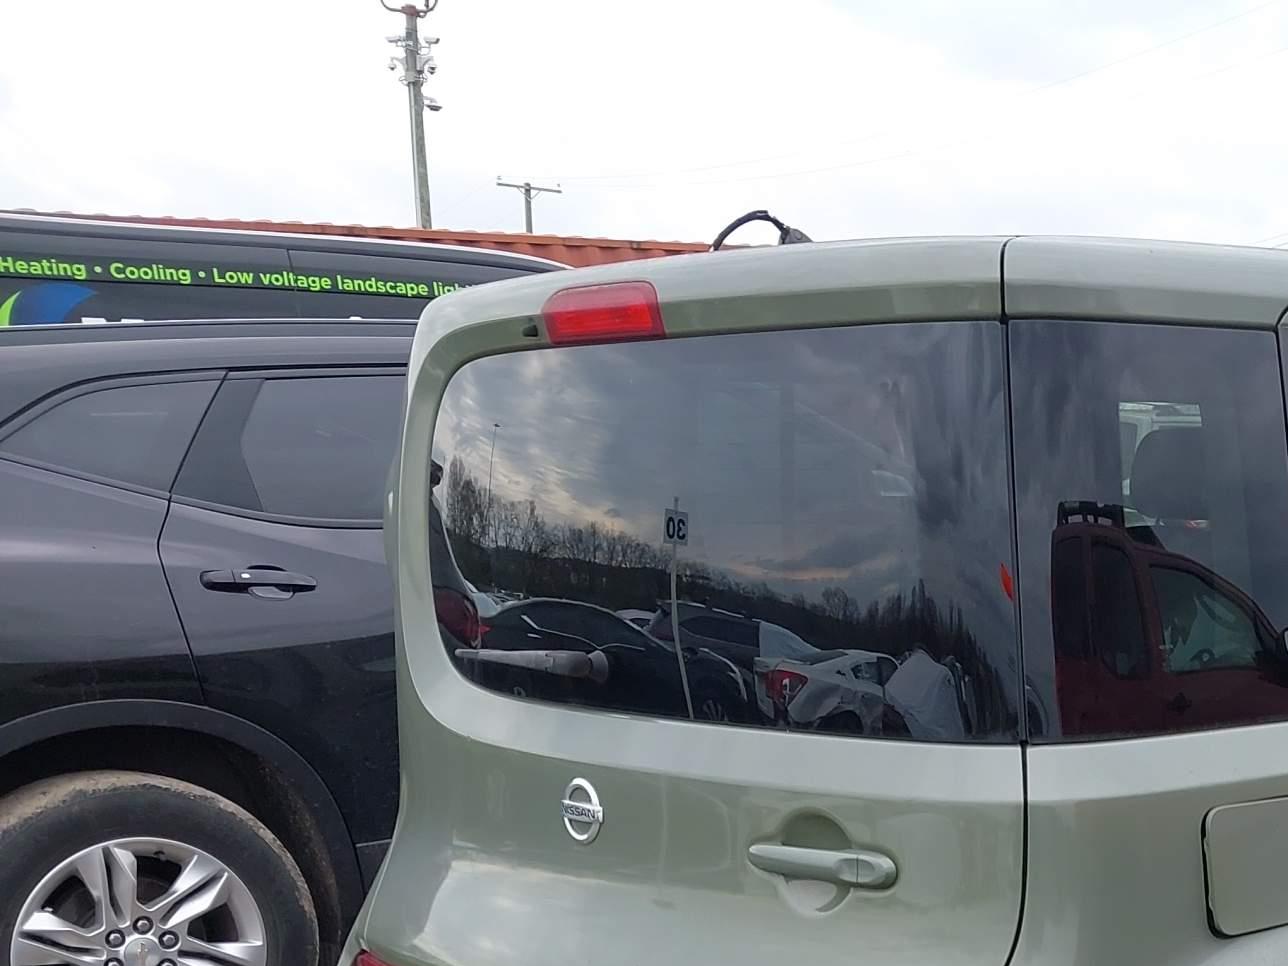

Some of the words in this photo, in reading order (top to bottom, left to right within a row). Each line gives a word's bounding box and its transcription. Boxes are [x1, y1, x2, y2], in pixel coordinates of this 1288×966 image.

[0, 256, 87, 280] Heating
[110, 262, 191, 285] Cooling
[213, 267, 253, 284] Low
[260, 271, 334, 292] voltage
[337, 274, 429, 297] landscape
